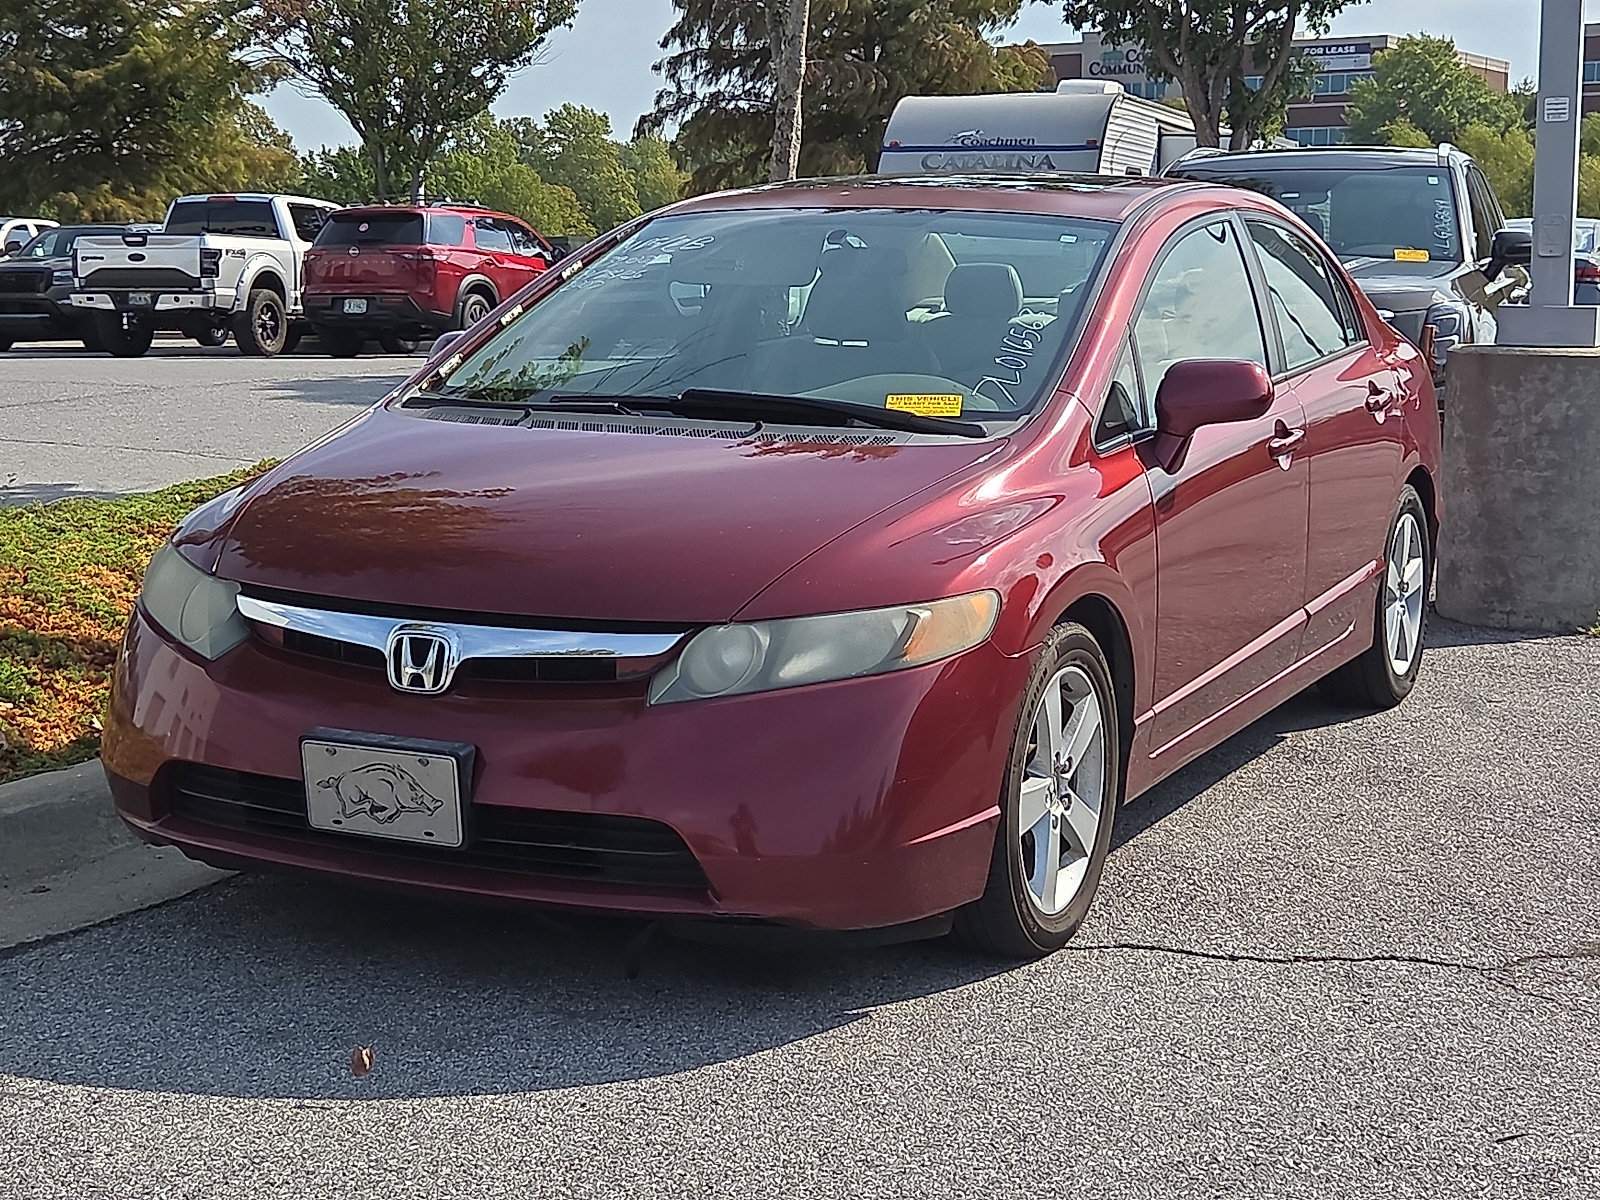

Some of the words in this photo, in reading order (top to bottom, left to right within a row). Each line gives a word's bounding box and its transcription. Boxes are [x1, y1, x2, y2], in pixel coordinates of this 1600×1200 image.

[1303, 47, 1324, 55] FOR
[1326, 46, 1356, 54] LEASE
[960, 137, 1036, 147] Coachmen
[921, 153, 1057, 170] CATALINA
